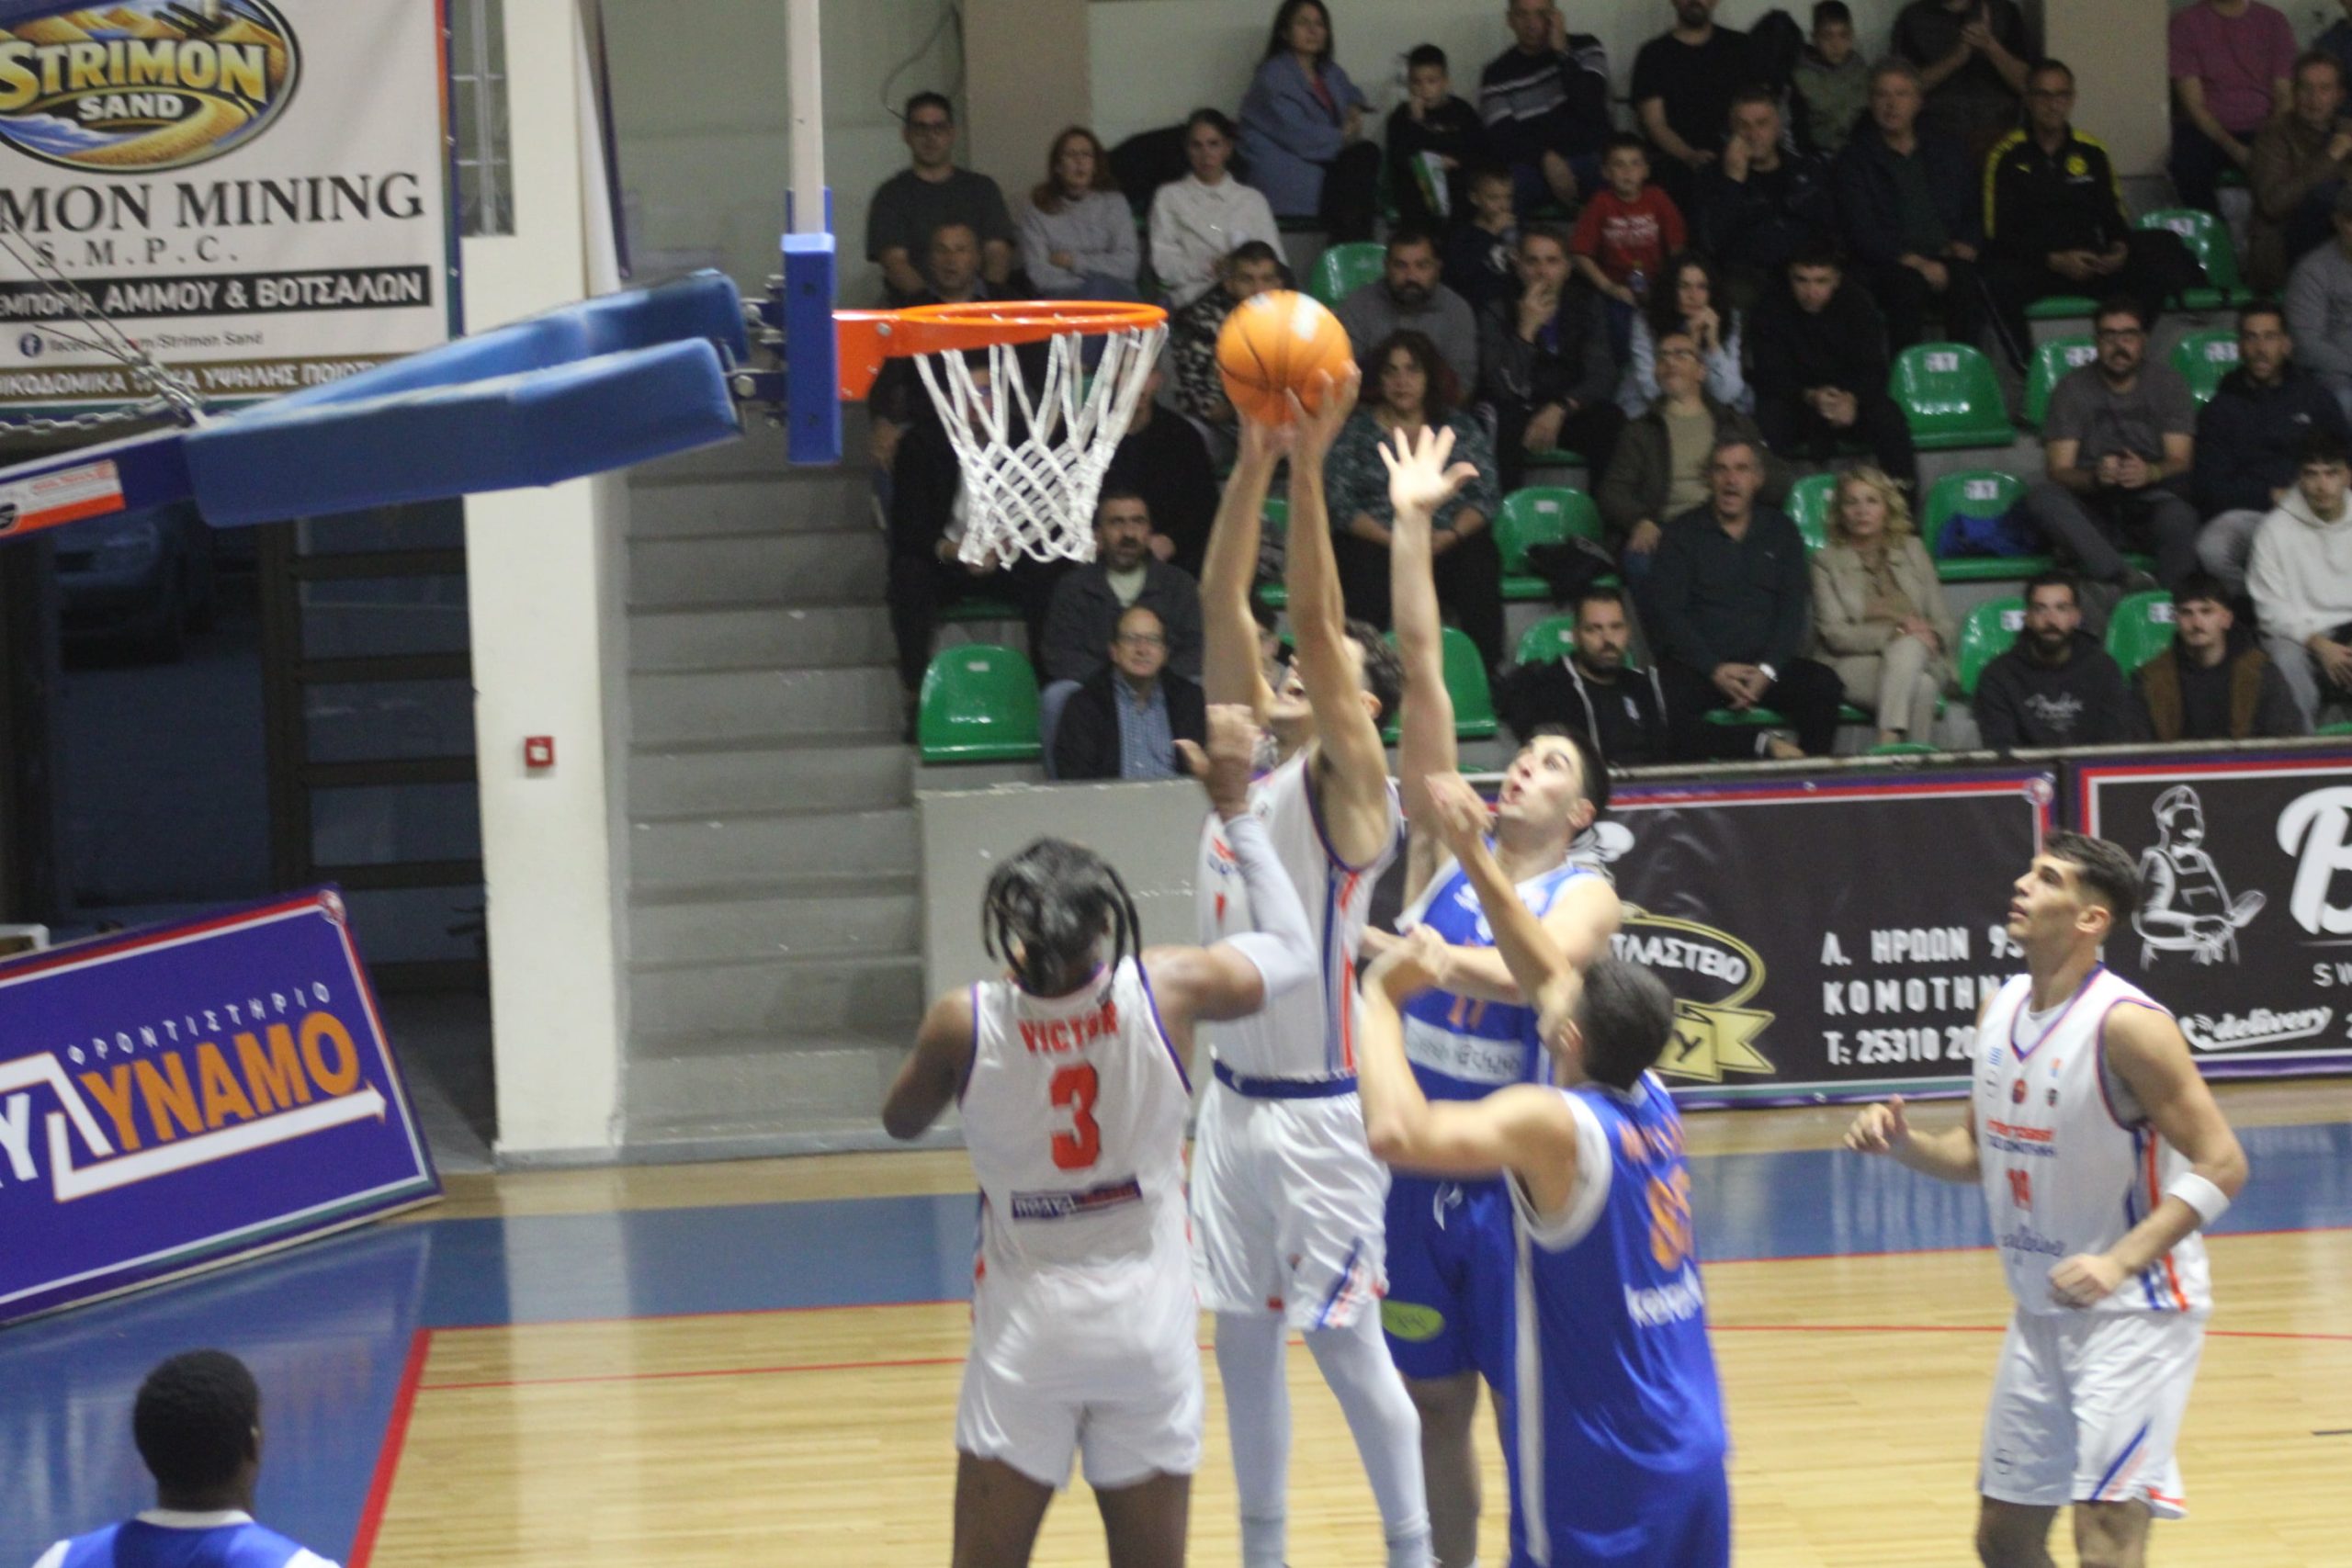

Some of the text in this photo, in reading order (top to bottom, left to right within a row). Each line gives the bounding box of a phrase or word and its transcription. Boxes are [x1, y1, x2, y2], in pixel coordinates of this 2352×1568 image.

[0, 39, 268, 109] STRIMON
[78, 93, 184, 120] SAND
[173, 173, 426, 229] MINING
[102, 281, 219, 313] ΑΜΜΟΥ
[224, 281, 250, 309] &
[255, 273, 424, 308] ΒΟΤΣΑΛΩΝ
[1824, 975, 2012, 1016] ΚΟΜΟΤΗΝ
[1018, 999, 1118, 1056] VICTOR
[1857, 1026, 1940, 1063] 25310
[1050, 1063, 1101, 1170] 3
